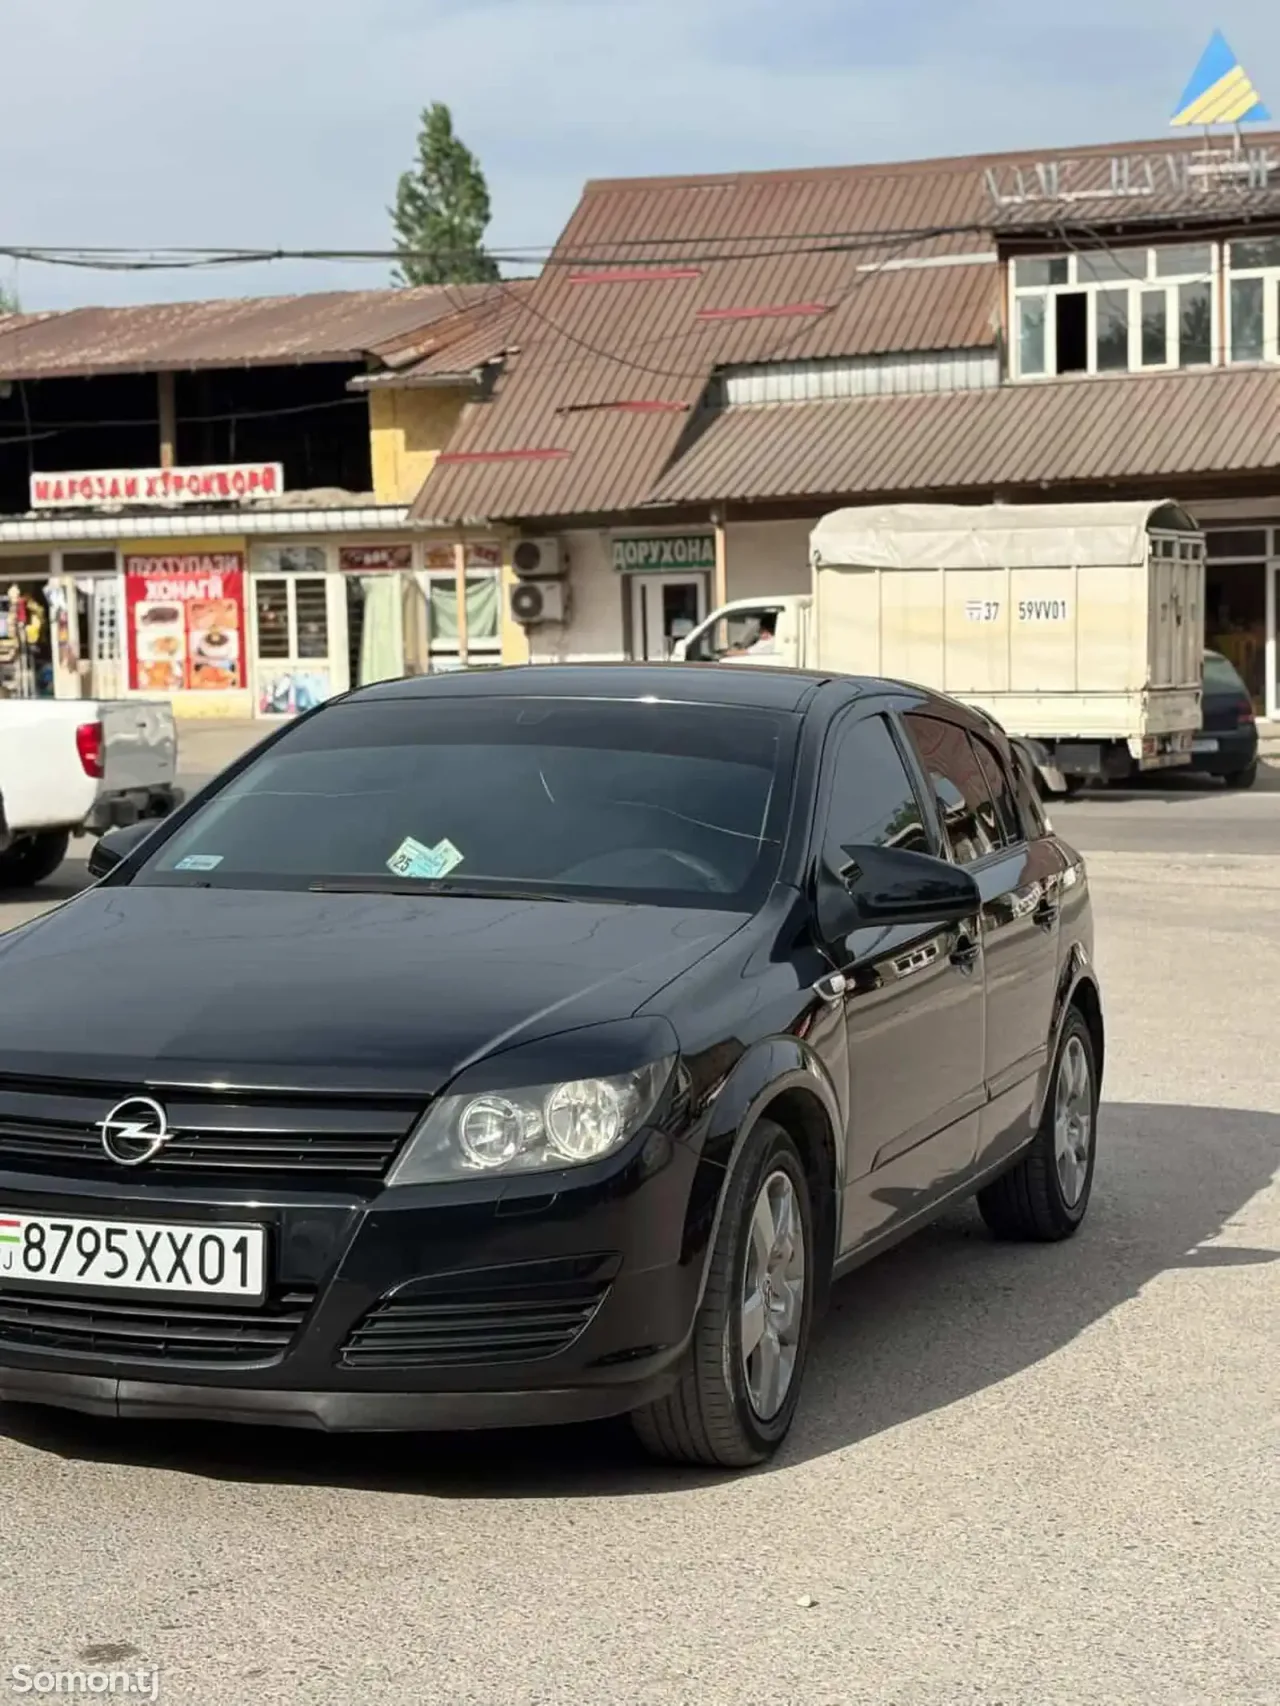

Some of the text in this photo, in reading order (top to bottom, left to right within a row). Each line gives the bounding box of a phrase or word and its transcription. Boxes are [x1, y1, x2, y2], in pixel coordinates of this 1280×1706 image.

[613, 538, 714, 570] ДОРУХОНА
[984, 600, 1066, 620] 37 59VV01
[393, 854, 413, 873] 25
[23, 1222, 248, 1288] 8795XX01
